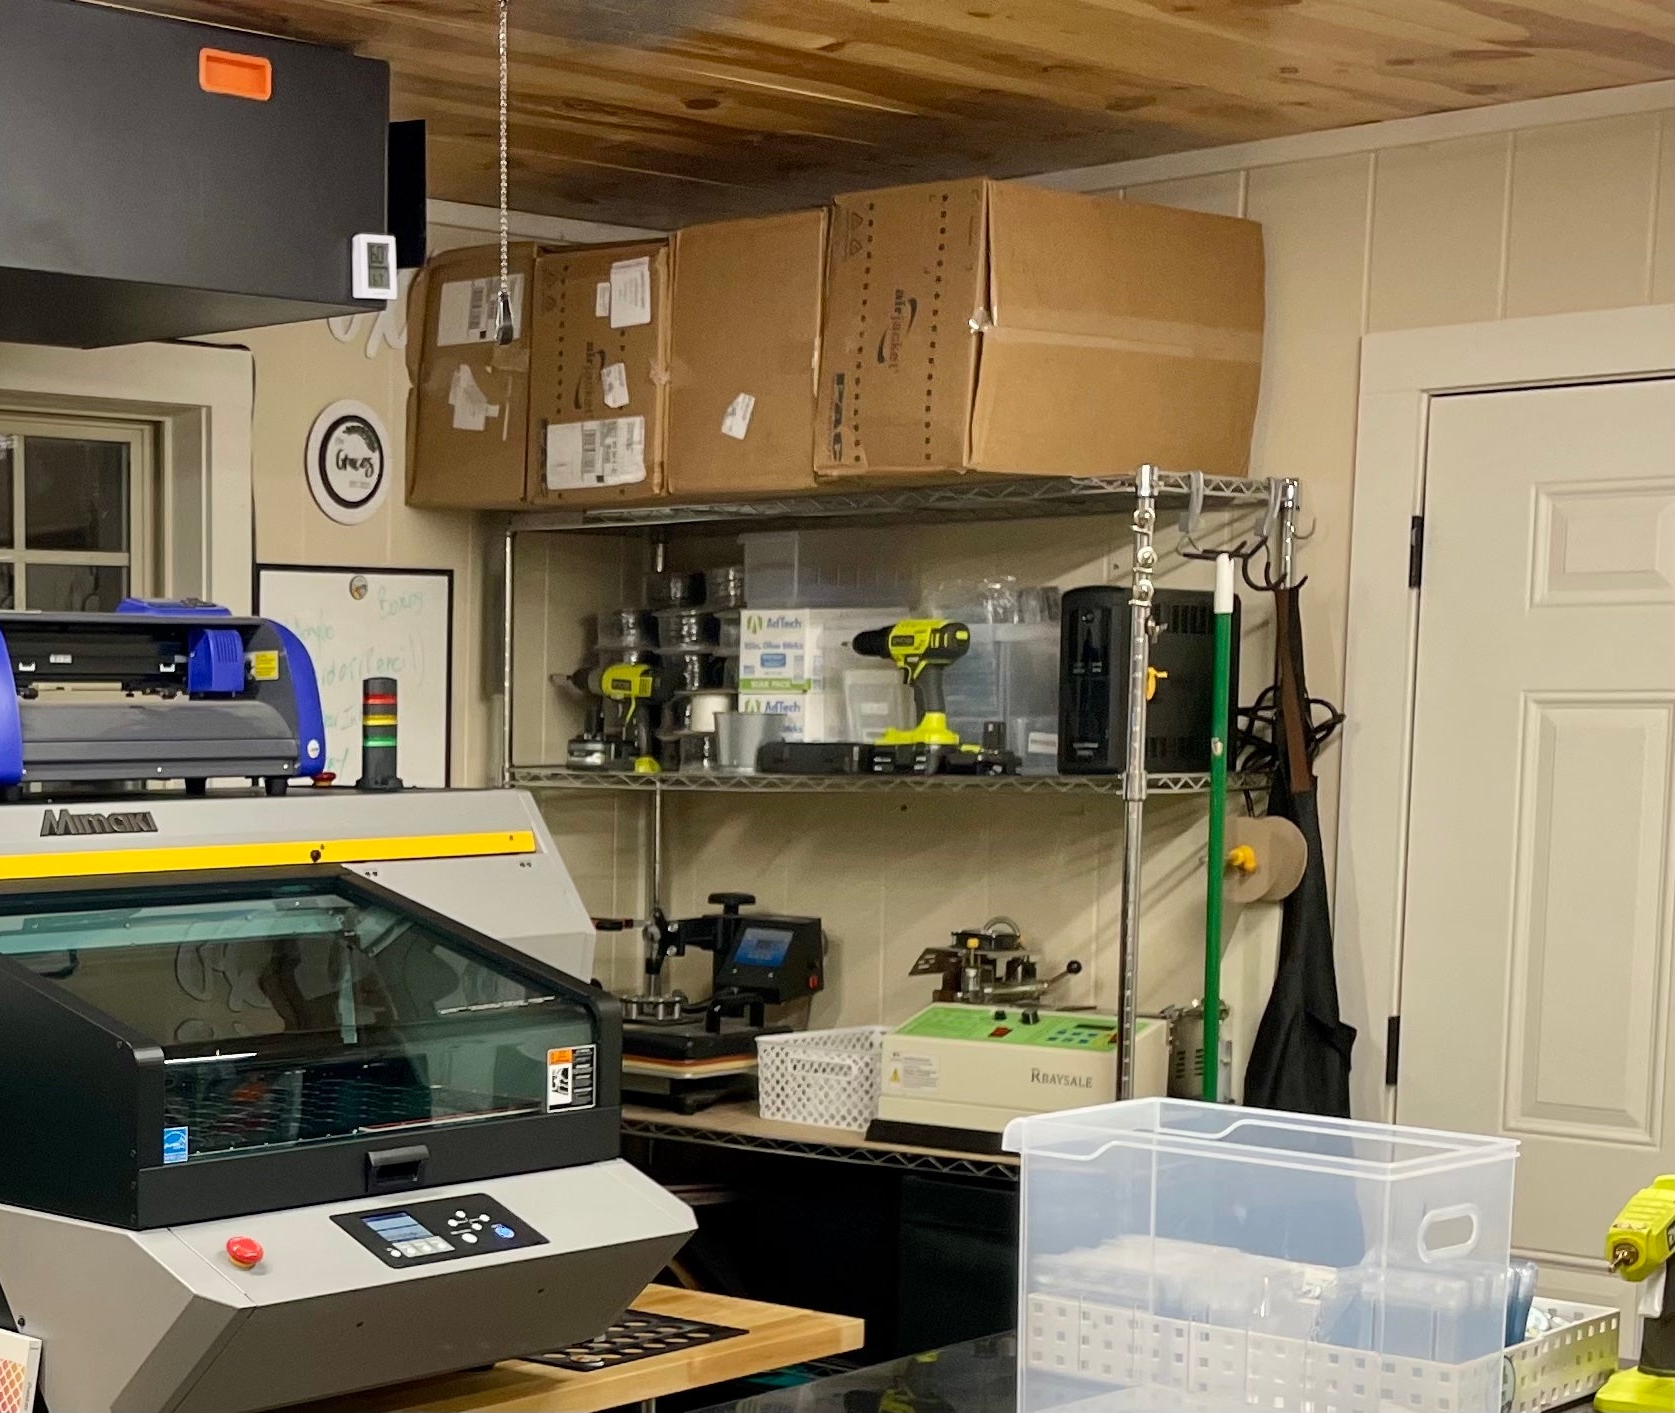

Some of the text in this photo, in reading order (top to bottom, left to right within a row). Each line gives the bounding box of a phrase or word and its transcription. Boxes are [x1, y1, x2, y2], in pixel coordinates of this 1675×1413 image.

[766, 617, 802, 629] AdTech
[765, 701, 801, 713] AdTech
[40, 809, 158, 837] Mimaki
